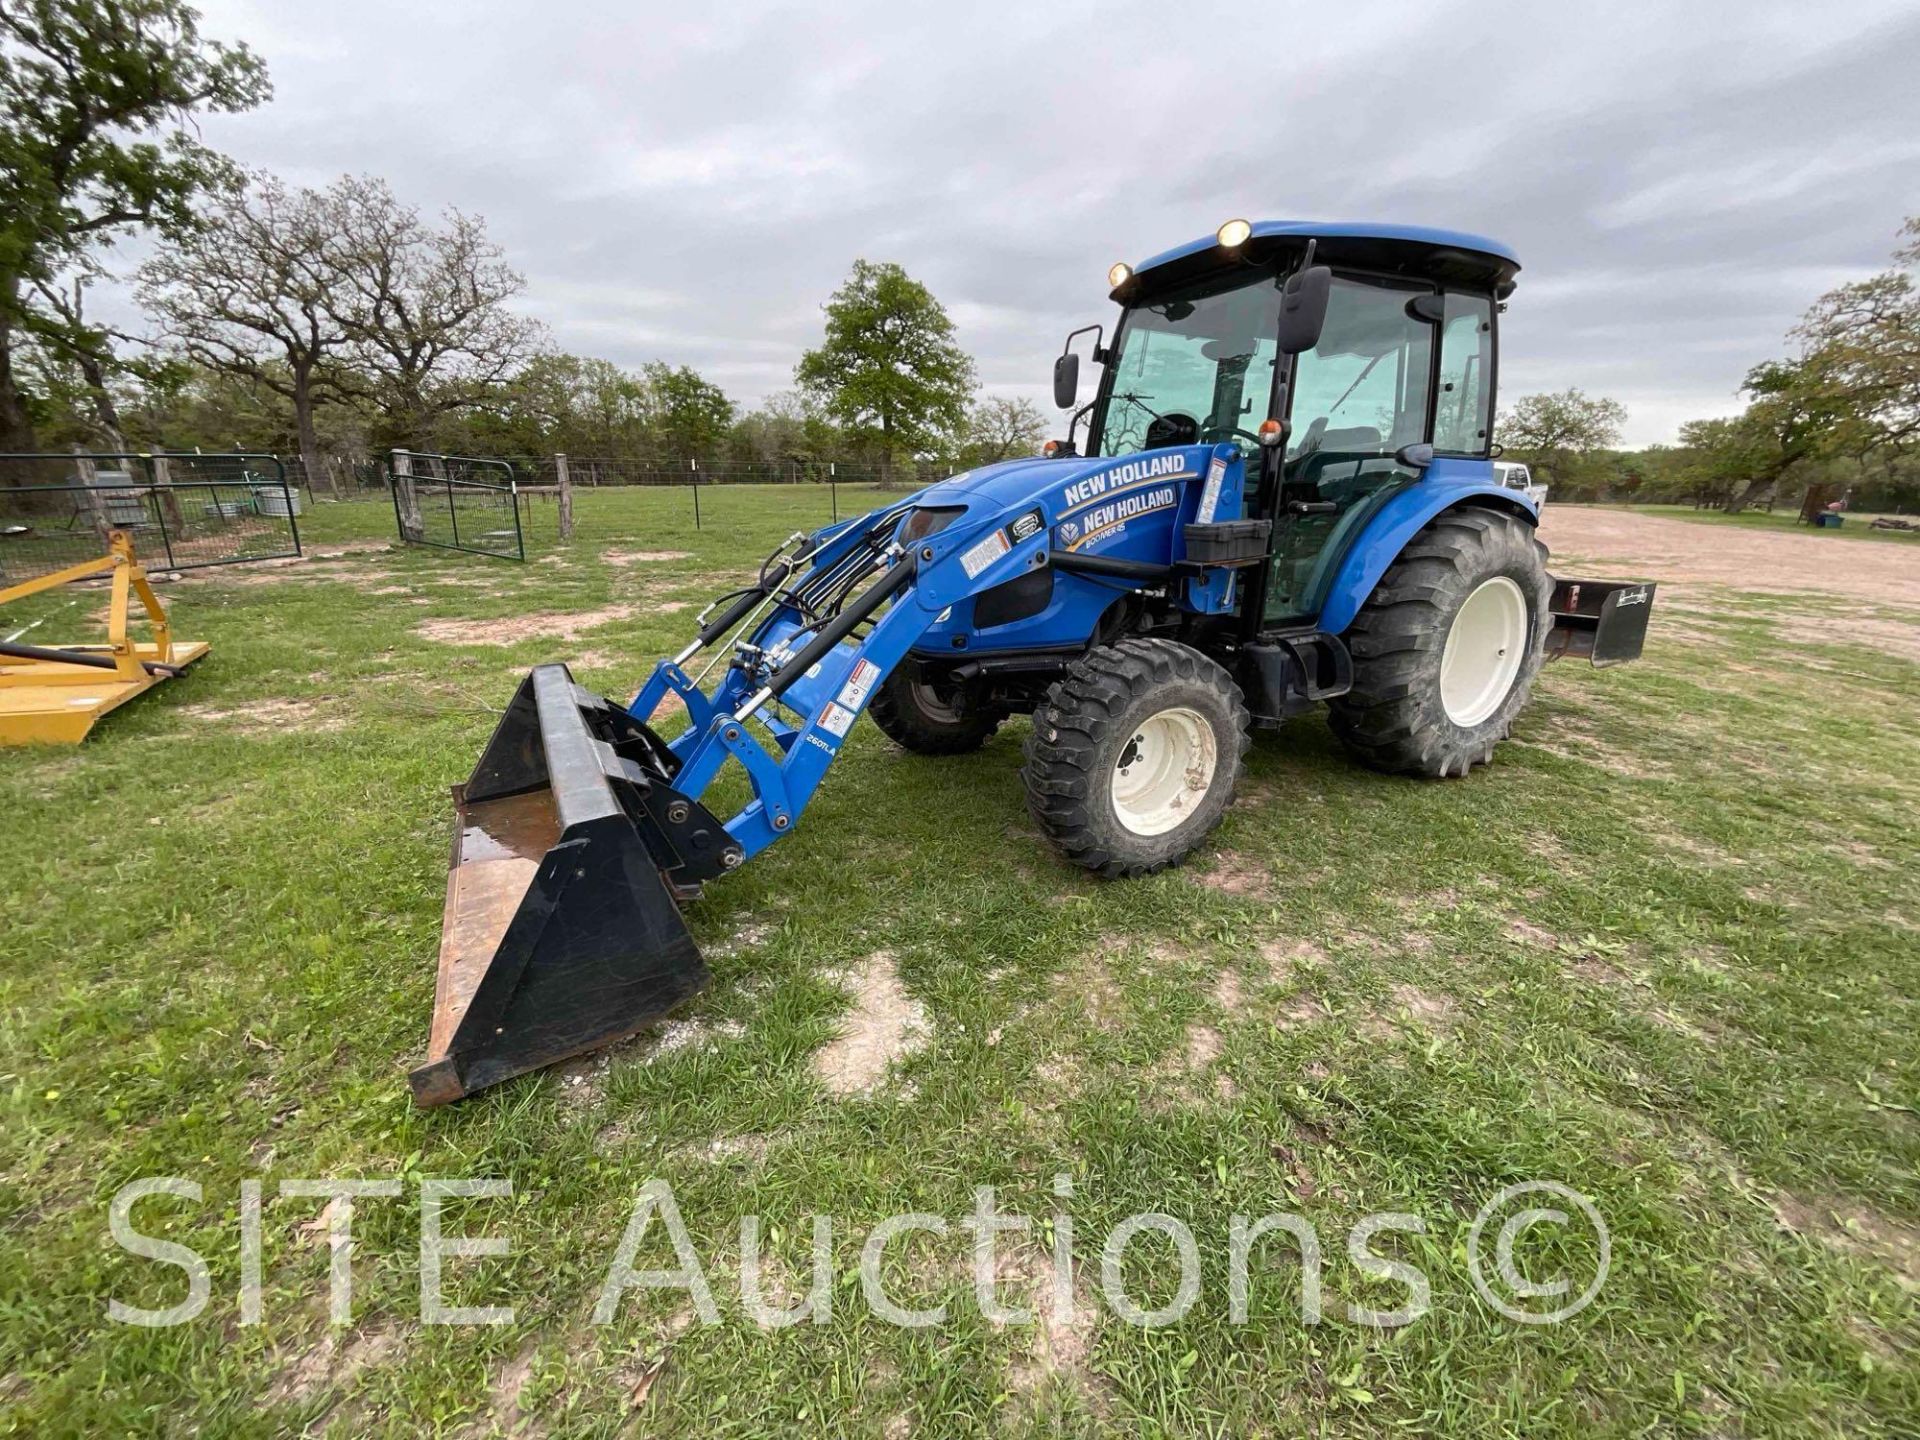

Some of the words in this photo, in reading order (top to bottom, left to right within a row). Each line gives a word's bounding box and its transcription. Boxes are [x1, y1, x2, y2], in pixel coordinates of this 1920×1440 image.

[1064, 470, 1106, 507] NEW
[1109, 454, 1185, 488] HOLLAND
[1083, 507, 1115, 533] NEW
[1117, 488, 1174, 518] HOLLAND
[1085, 526, 1116, 549] BOOMER
